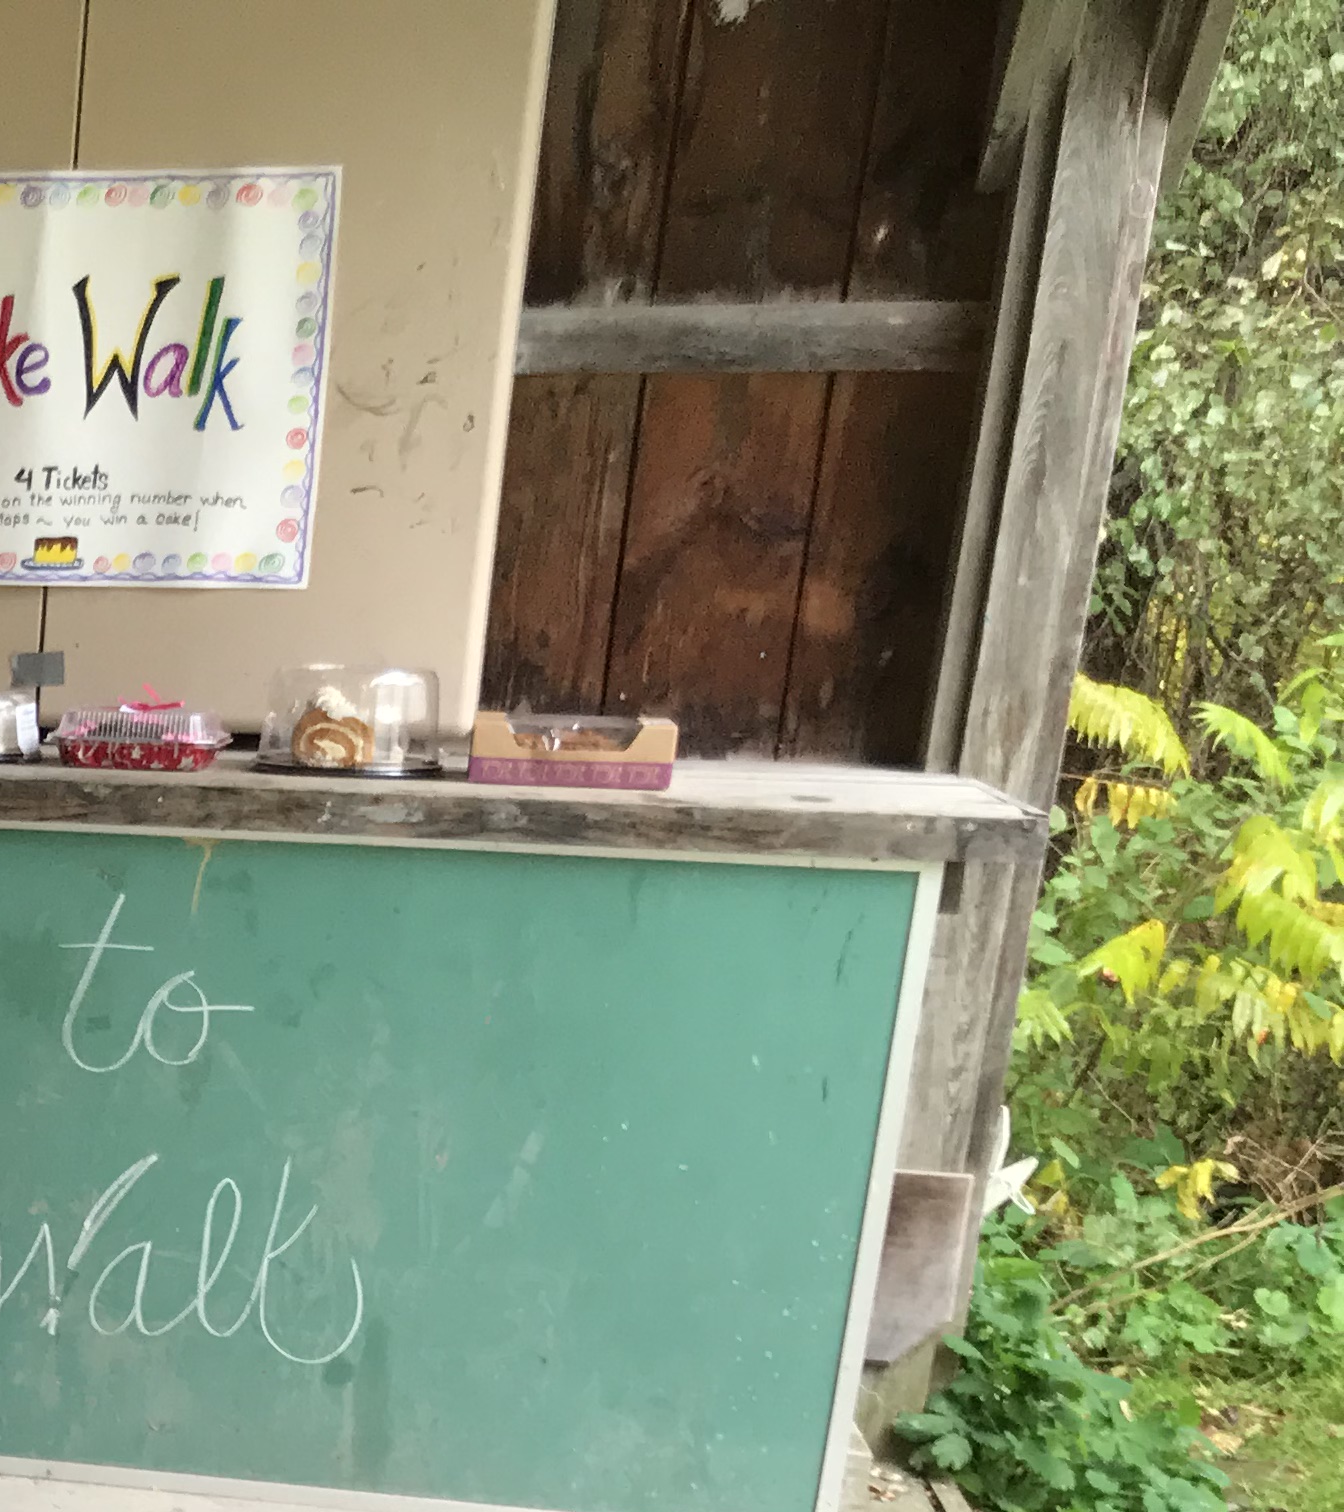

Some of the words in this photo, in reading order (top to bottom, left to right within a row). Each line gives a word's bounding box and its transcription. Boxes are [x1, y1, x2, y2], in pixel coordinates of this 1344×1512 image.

[72, 273, 244, 431] Walk
[14, 467, 33, 491] 4
[42, 464, 108, 491] Tickets
[1, 497, 21, 508] on
[30, 493, 52, 507] the
[59, 491, 121, 513] winning
[130, 490, 192, 506] number
[200, 491, 246, 510] when
[64, 514, 90, 528] you
[100, 514, 127, 525] win
[136, 514, 148, 526] a
[59, 893, 254, 1072] to
